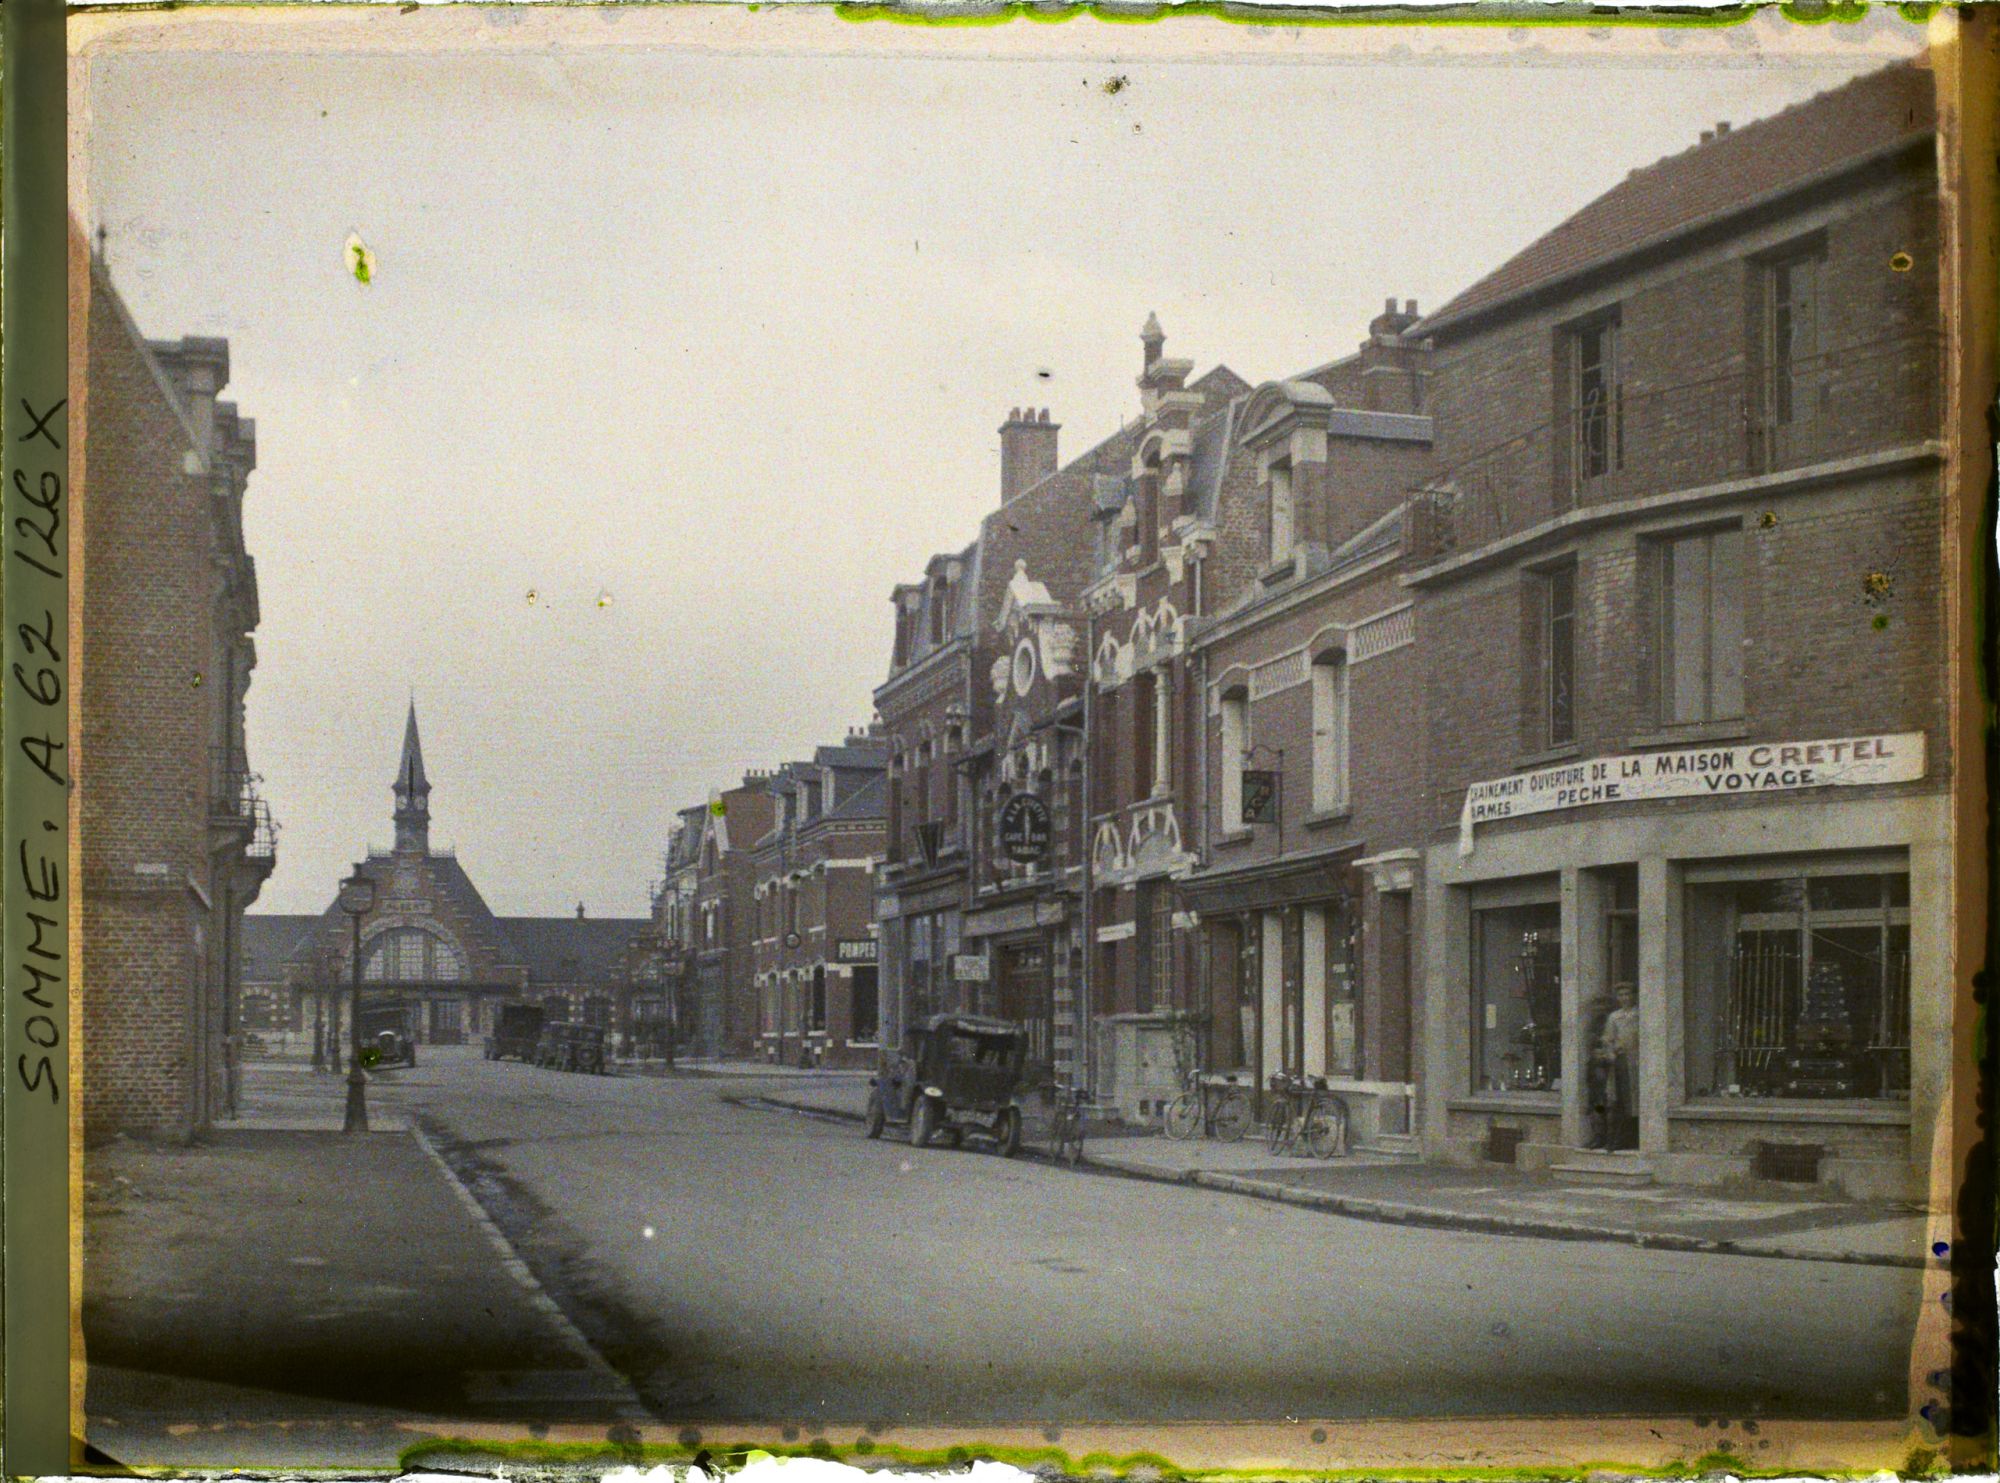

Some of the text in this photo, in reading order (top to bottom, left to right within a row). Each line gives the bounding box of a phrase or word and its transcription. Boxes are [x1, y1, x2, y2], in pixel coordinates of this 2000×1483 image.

[18, 398, 68, 449] X
[13, 468, 63, 579] 126
[12, 609, 61, 706] 62
[20, 731, 65, 786] A
[1530, 766, 1585, 792] OUVERTURE
[1592, 762, 1607, 780] DE
[1621, 760, 1642, 777] LA
[1655, 751, 1734, 776] MAISON
[1749, 738, 1895, 769] CRETEL
[1471, 769, 1815, 819] ARMES PECHE VOYAGE
